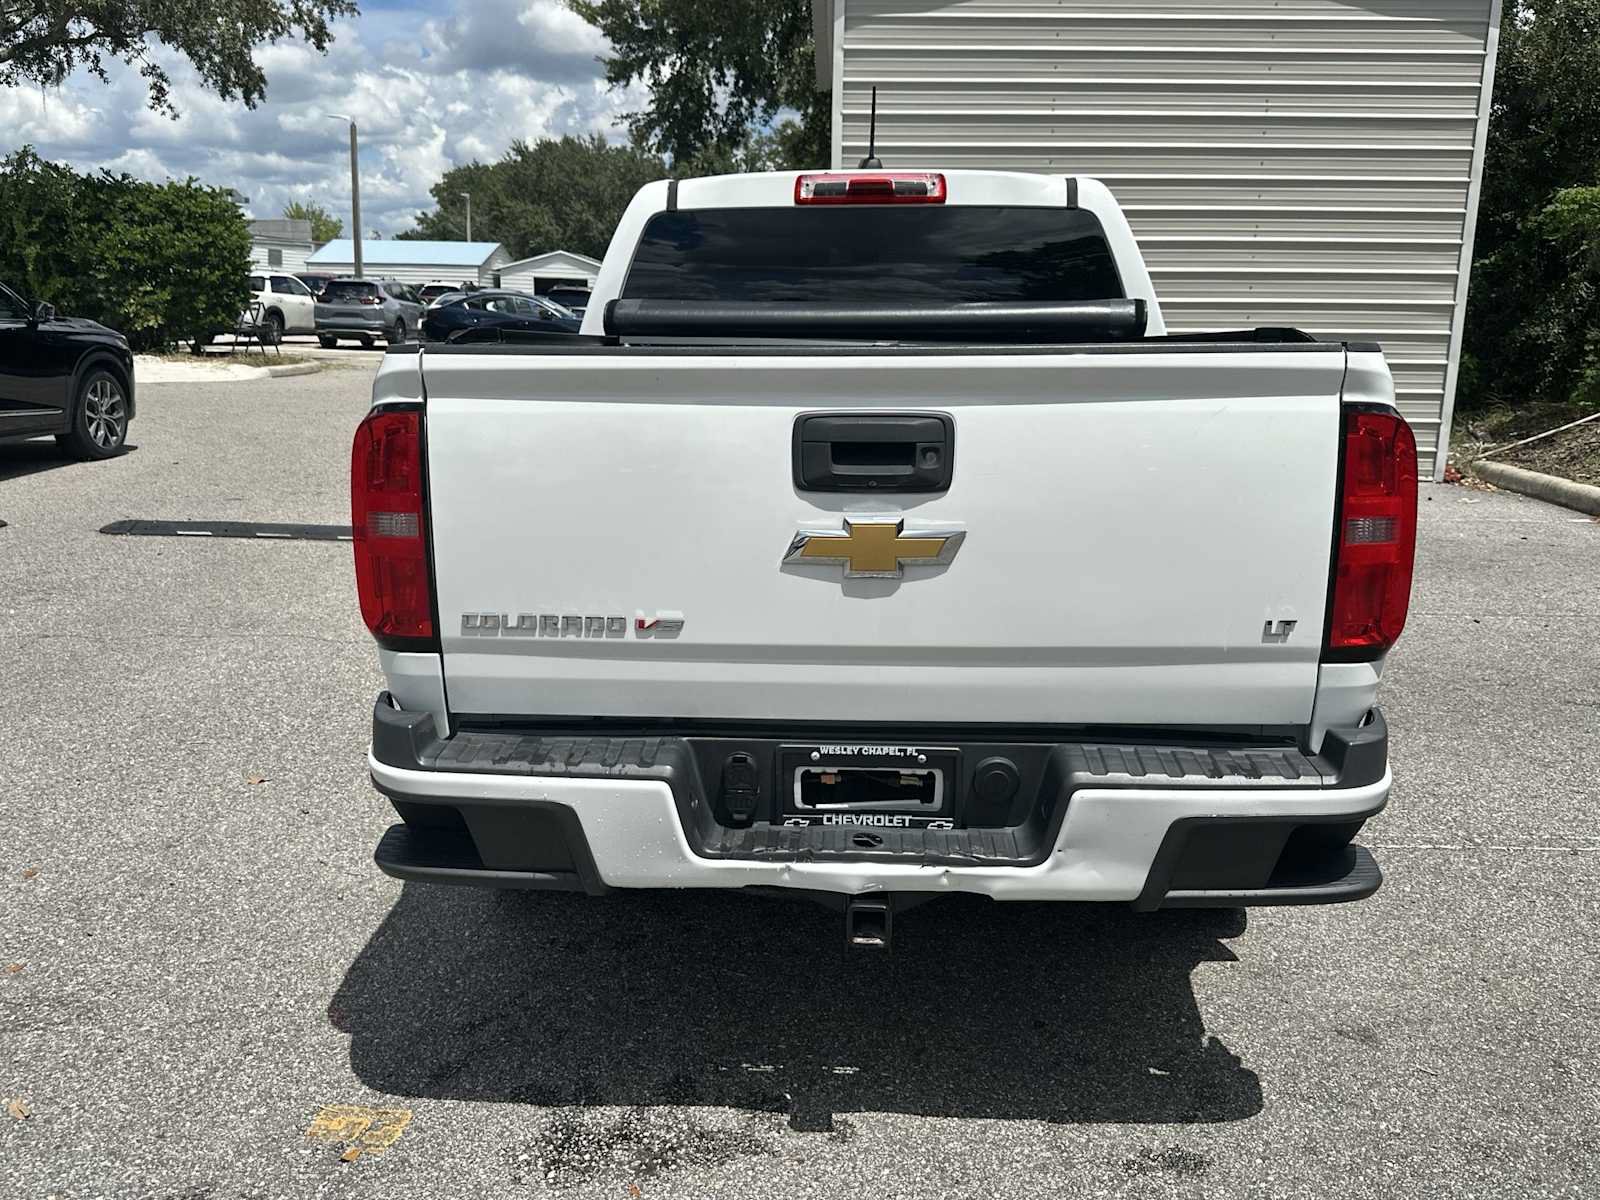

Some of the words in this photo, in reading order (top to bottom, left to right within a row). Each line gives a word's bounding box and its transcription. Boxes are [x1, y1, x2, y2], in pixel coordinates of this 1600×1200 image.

[461, 613, 627, 638] COLORADO
[1261, 620, 1297, 643] LT
[820, 745, 860, 755] WESLEY
[862, 746, 904, 757] CHAPEL,
[906, 748, 918, 756] FL
[823, 815, 912, 827] CHEVROLET
